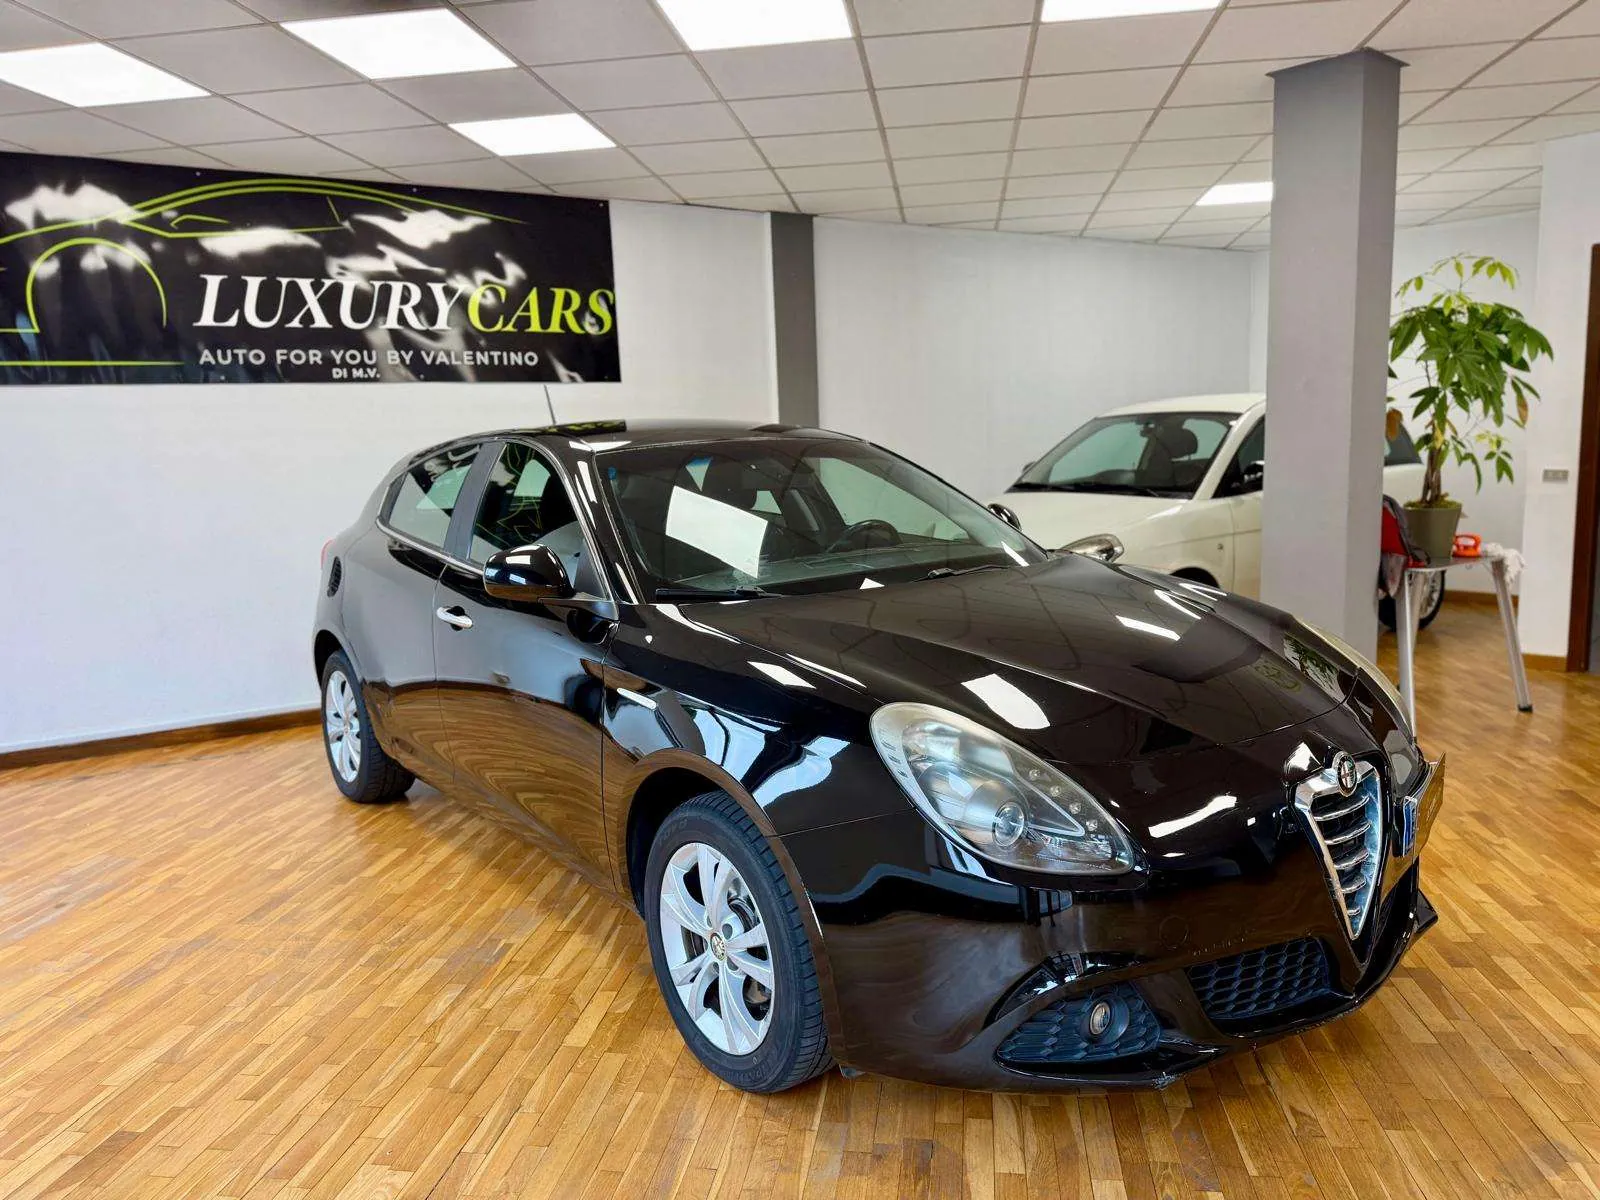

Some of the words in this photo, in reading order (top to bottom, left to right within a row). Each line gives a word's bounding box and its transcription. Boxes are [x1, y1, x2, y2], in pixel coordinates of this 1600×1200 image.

[199, 349, 266, 365] AUTO
[276, 349, 322, 365] FOR
[331, 349, 377, 365] YOU
[387, 350, 414, 365] BY
[420, 350, 539, 366] VALENTINO
[332, 368, 348, 378] DI
[352, 368, 381, 379] M.V.
